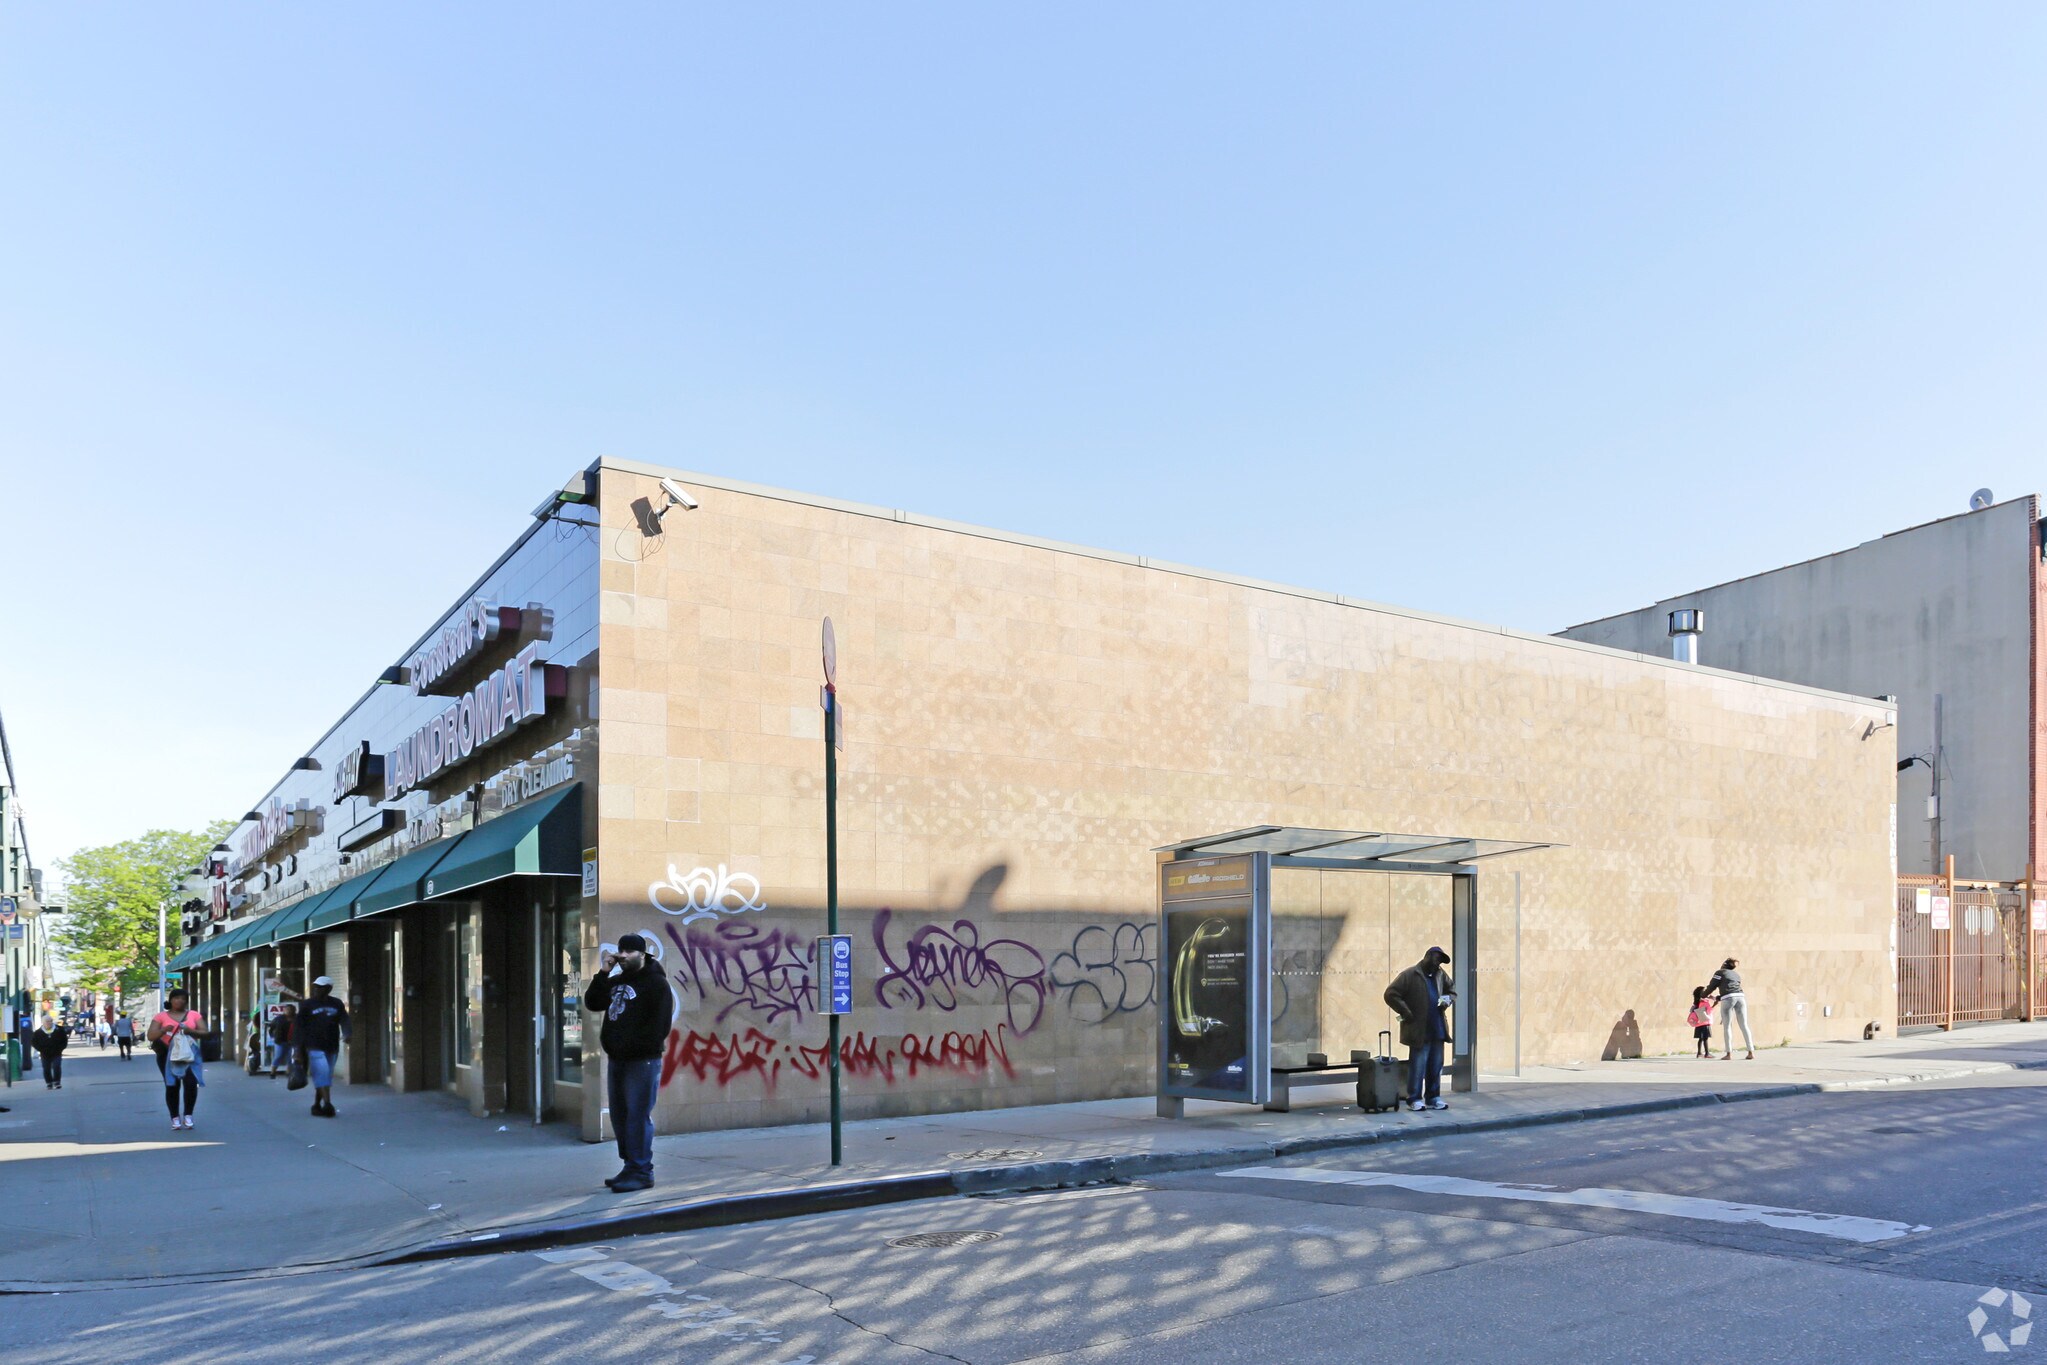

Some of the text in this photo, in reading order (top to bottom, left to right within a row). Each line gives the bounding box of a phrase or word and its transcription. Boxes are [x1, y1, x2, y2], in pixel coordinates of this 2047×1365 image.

[384, 639, 541, 801] LAUNDROMAT
[501, 754, 574, 808] DRY CLEANING
[834, 970, 849, 978] Stop
[835, 961, 848, 969] Bus
